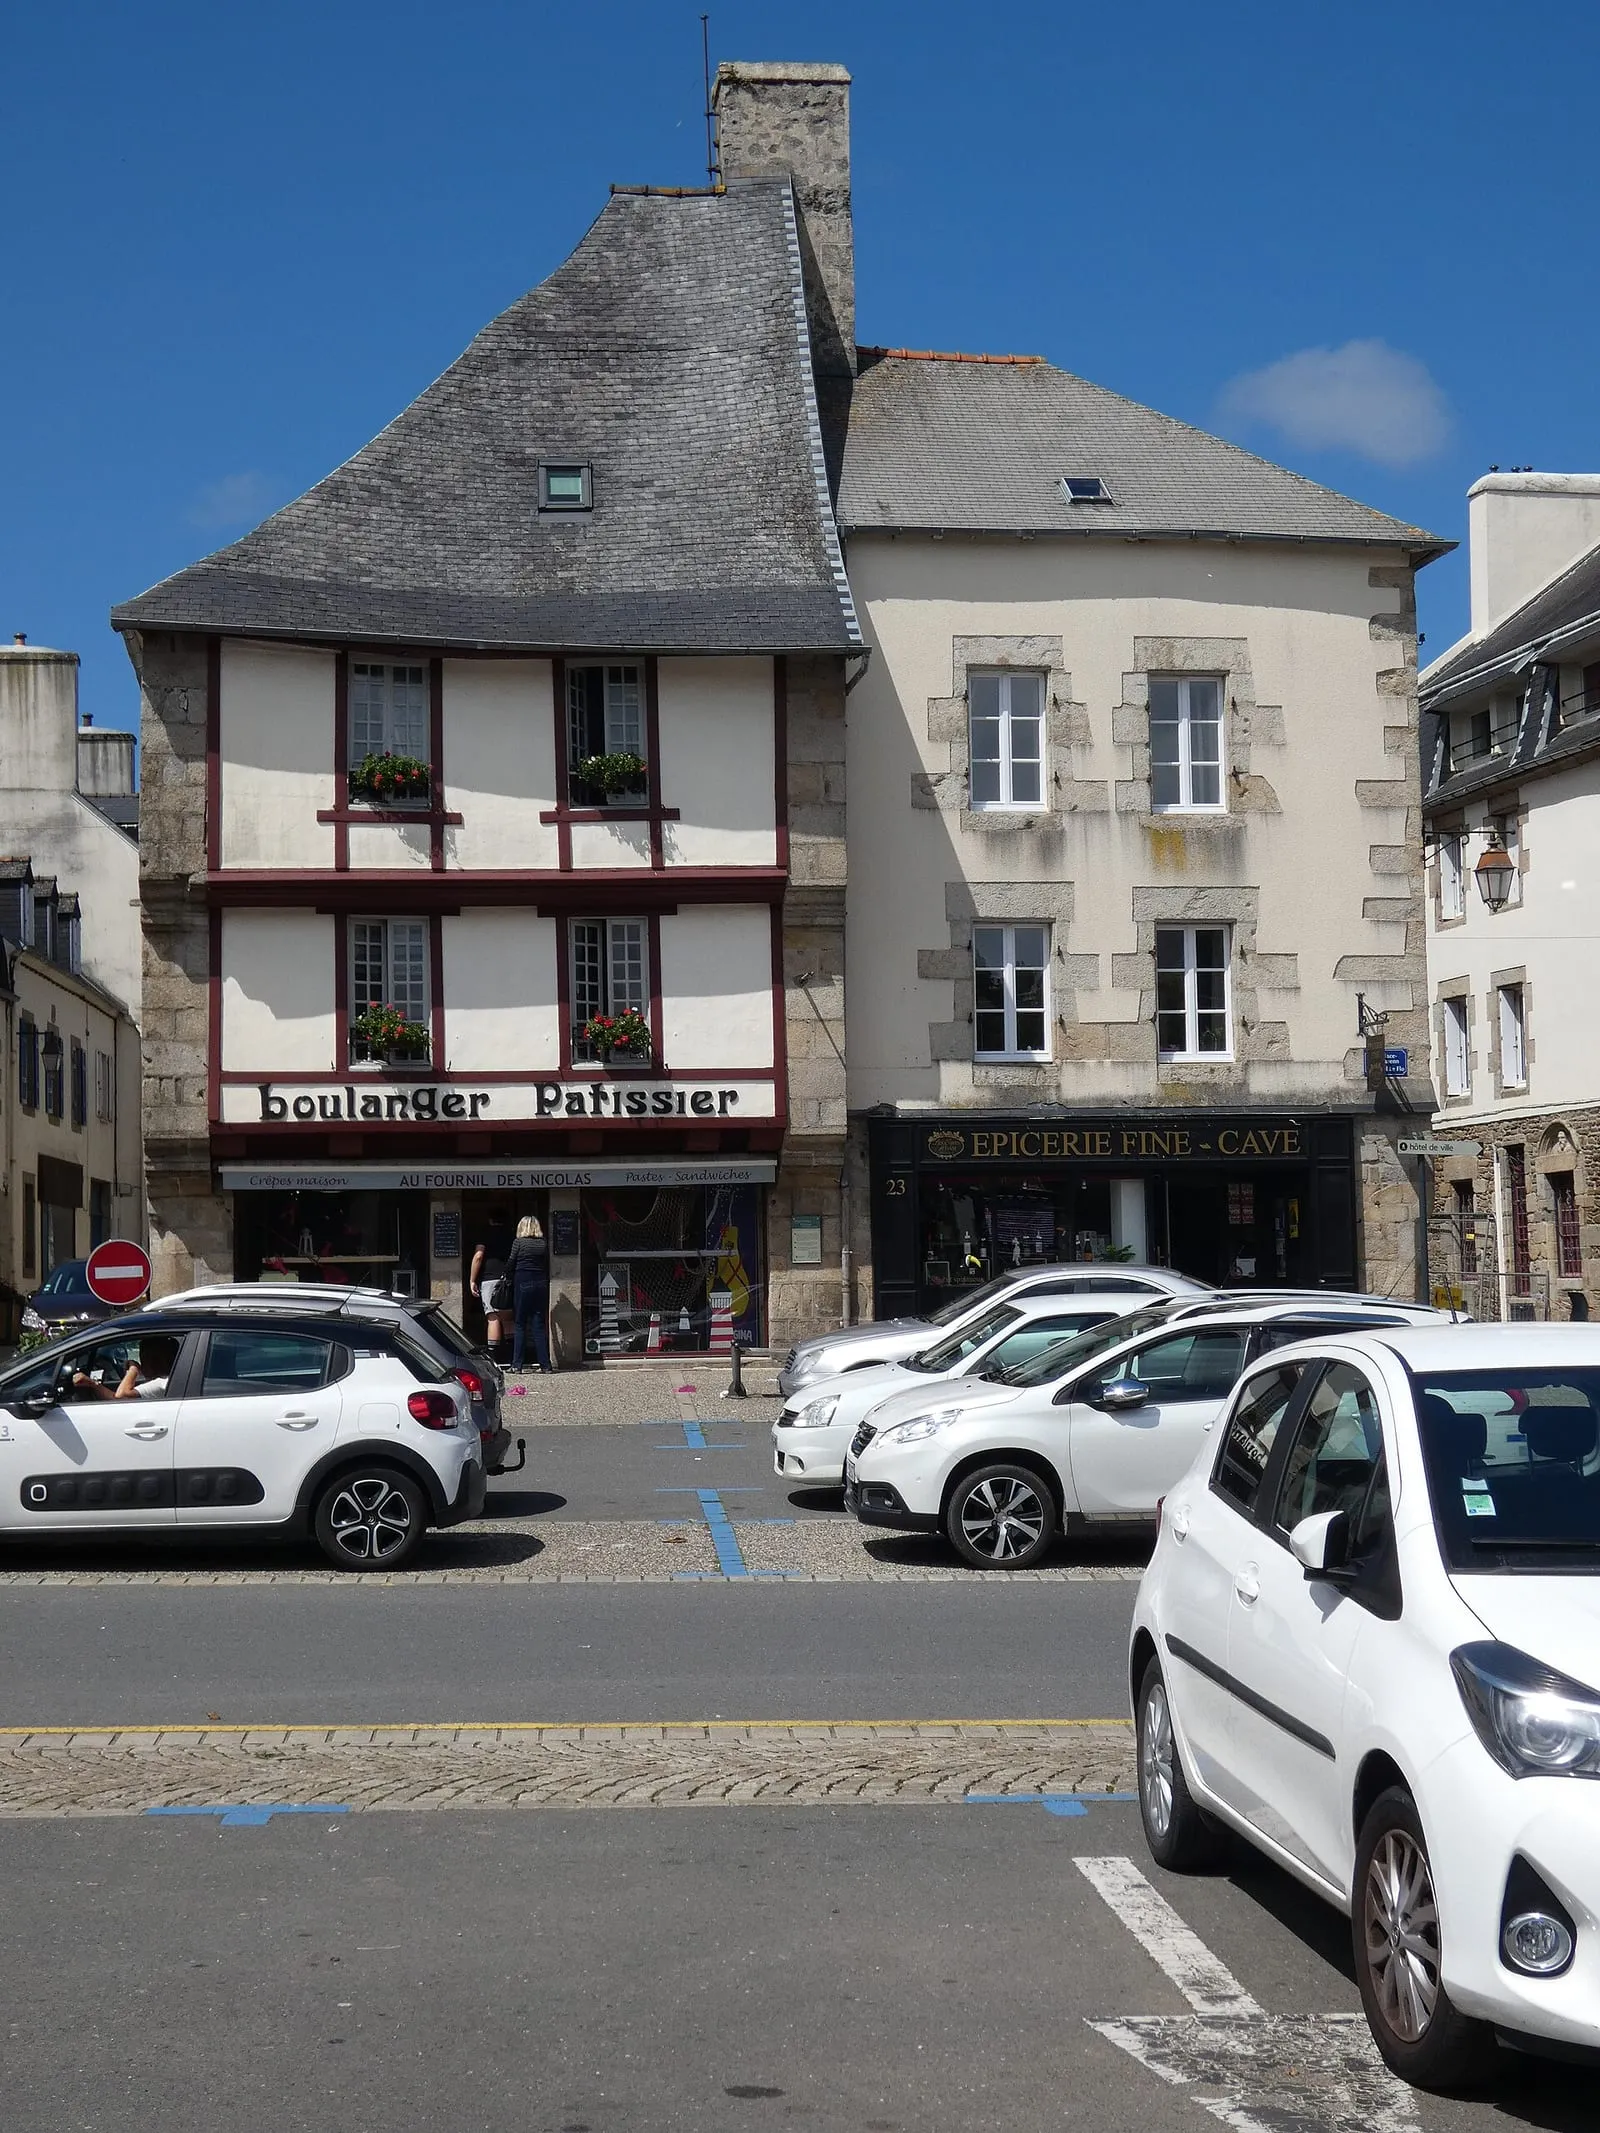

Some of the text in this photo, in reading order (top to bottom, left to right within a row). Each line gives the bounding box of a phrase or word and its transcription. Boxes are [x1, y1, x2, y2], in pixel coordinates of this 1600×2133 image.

[257, 1082, 740, 1121] boulanger Patissier
[971, 1131, 1113, 1156] EPICERIE
[1120, 1131, 1192, 1155] FINE
[1218, 1129, 1301, 1155] CAVE
[1409, 1142, 1454, 1152] hôtel de ville
[249, 1175, 350, 1189] Crêpes maison
[400, 1173, 592, 1187] AU FOURNIL DES NICOLAS
[625, 1171, 664, 1183] Pastes
[674, 1169, 752, 1182] Sandwiches
[886, 1179, 906, 1196] 23
[733, 1328, 753, 1342] GINA
